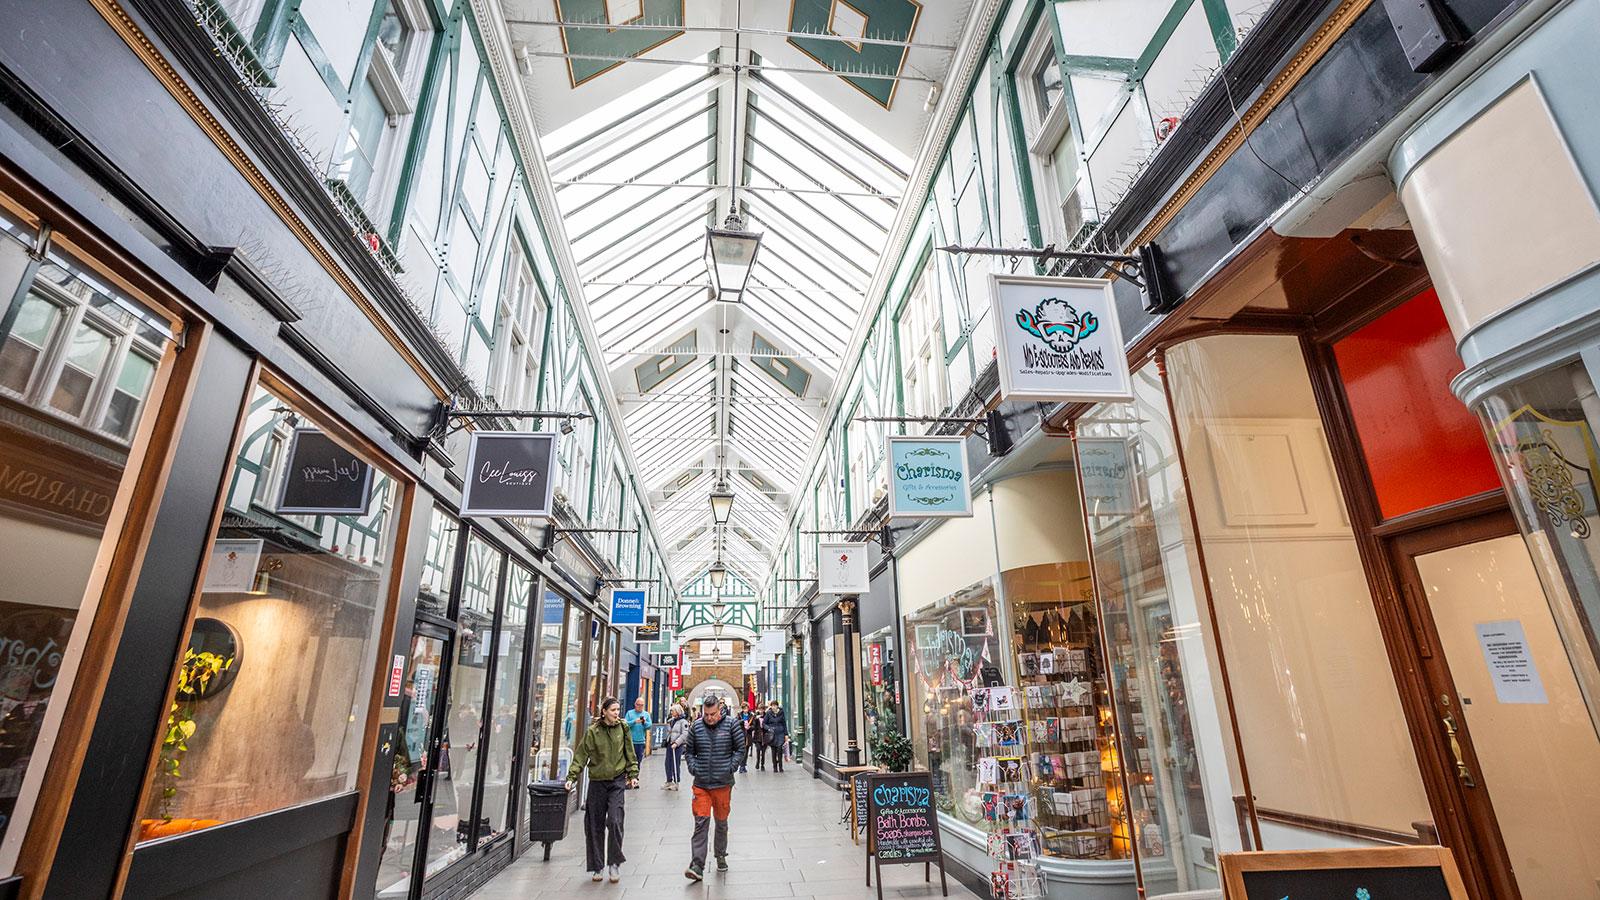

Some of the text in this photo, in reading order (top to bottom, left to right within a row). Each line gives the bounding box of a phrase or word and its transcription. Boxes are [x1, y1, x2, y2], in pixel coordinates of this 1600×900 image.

[1069, 350, 1082, 370] AND
[1079, 346, 1105, 371] REPAIRS
[896, 463, 963, 482] Charisma
[874, 783, 931, 808] Charisma
[877, 815, 899, 829] Bath
